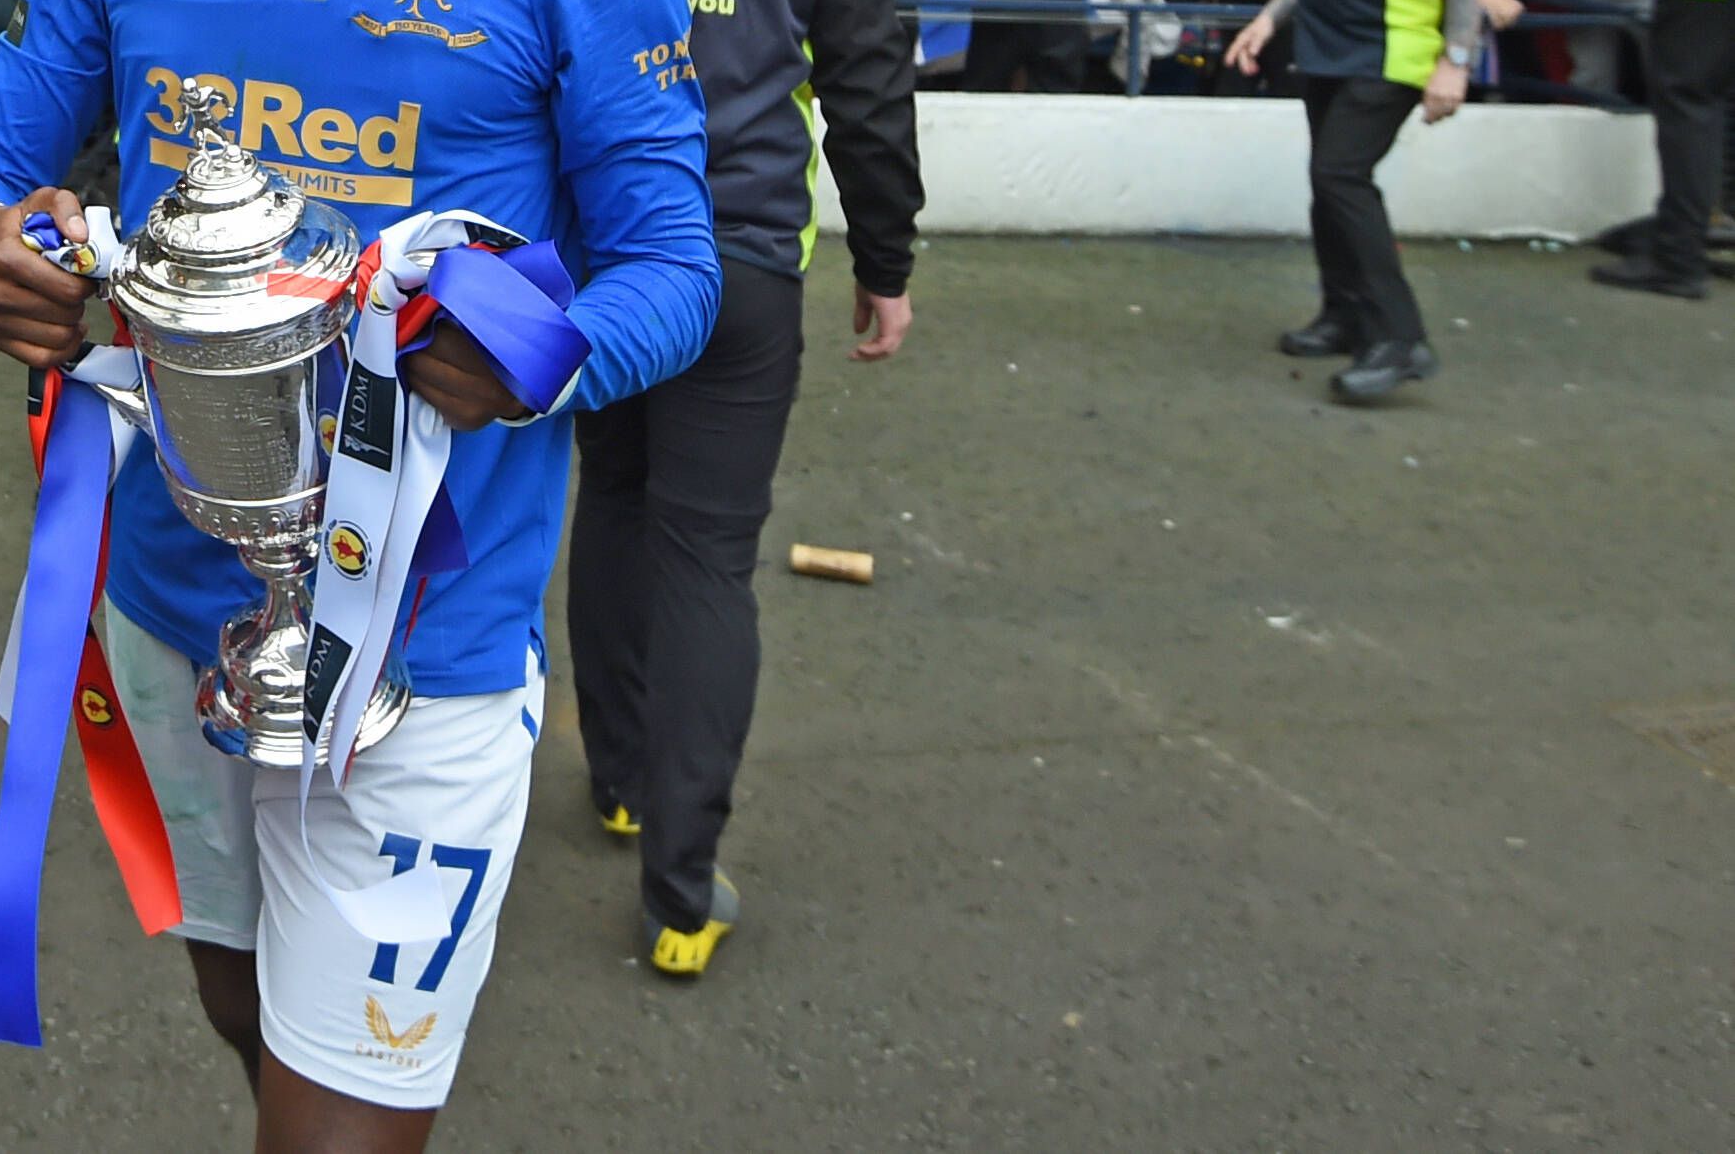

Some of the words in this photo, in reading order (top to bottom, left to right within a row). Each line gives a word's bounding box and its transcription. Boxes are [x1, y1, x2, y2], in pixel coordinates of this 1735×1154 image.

[349, 374, 371, 433] KDM
[367, 831, 493, 994] 17
[354, 1042, 424, 1070] CASTORE
